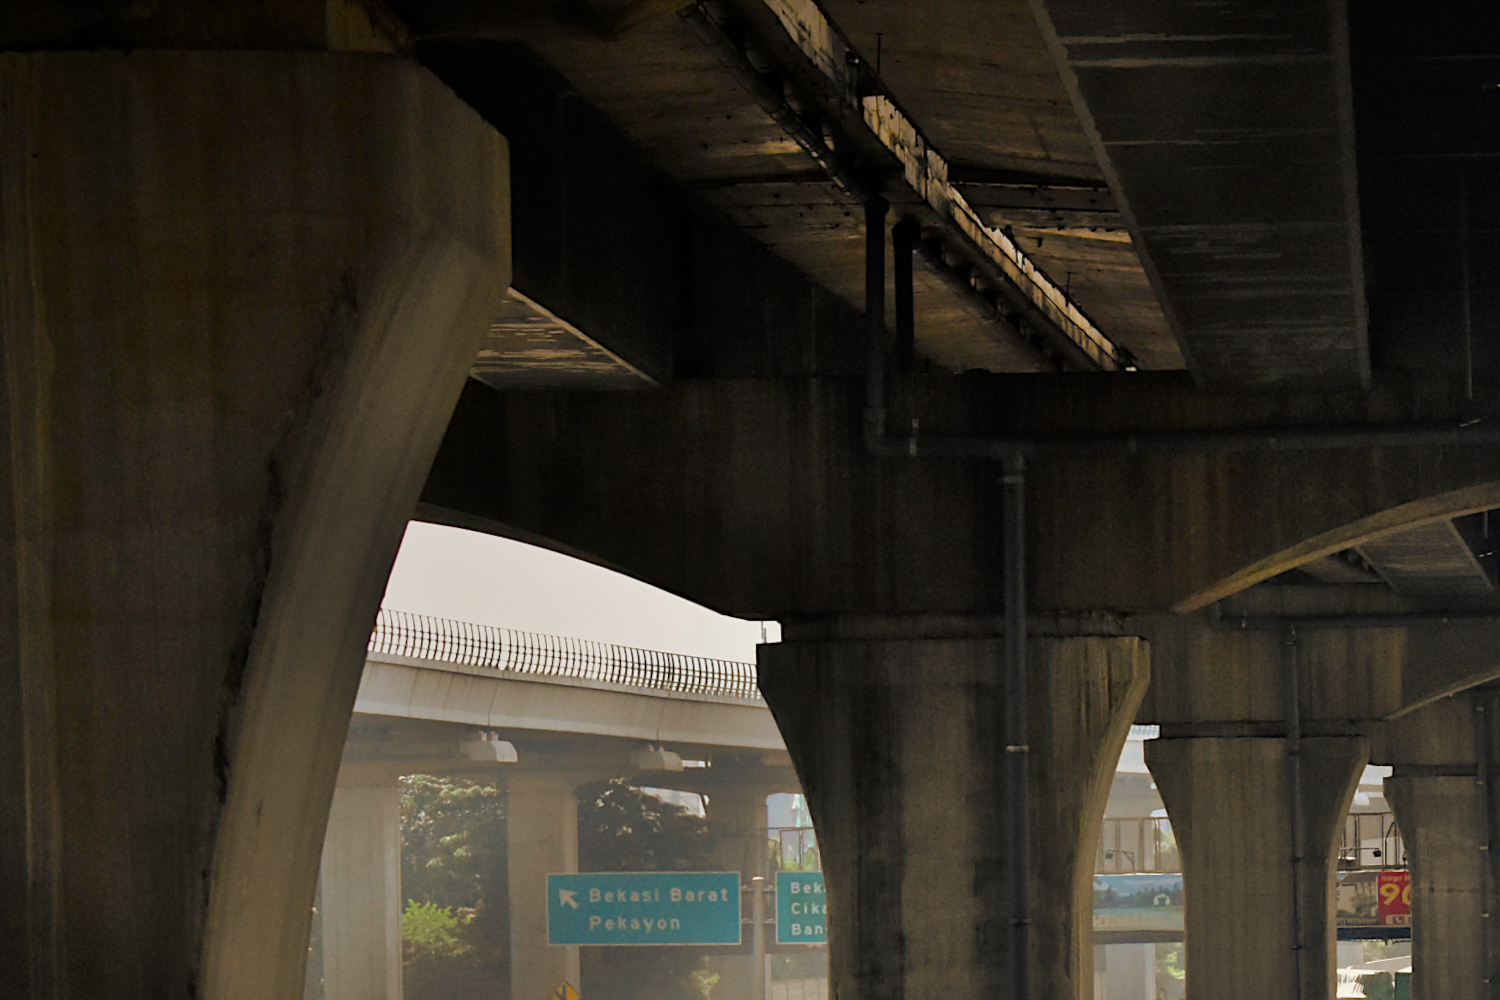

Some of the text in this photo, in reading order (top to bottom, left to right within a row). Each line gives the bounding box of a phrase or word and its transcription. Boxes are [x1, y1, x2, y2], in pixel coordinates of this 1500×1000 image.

[589, 887, 729, 903] Bekasi Barat
[589, 915, 681, 933] Pekayon
[791, 923, 827, 936] Ban
